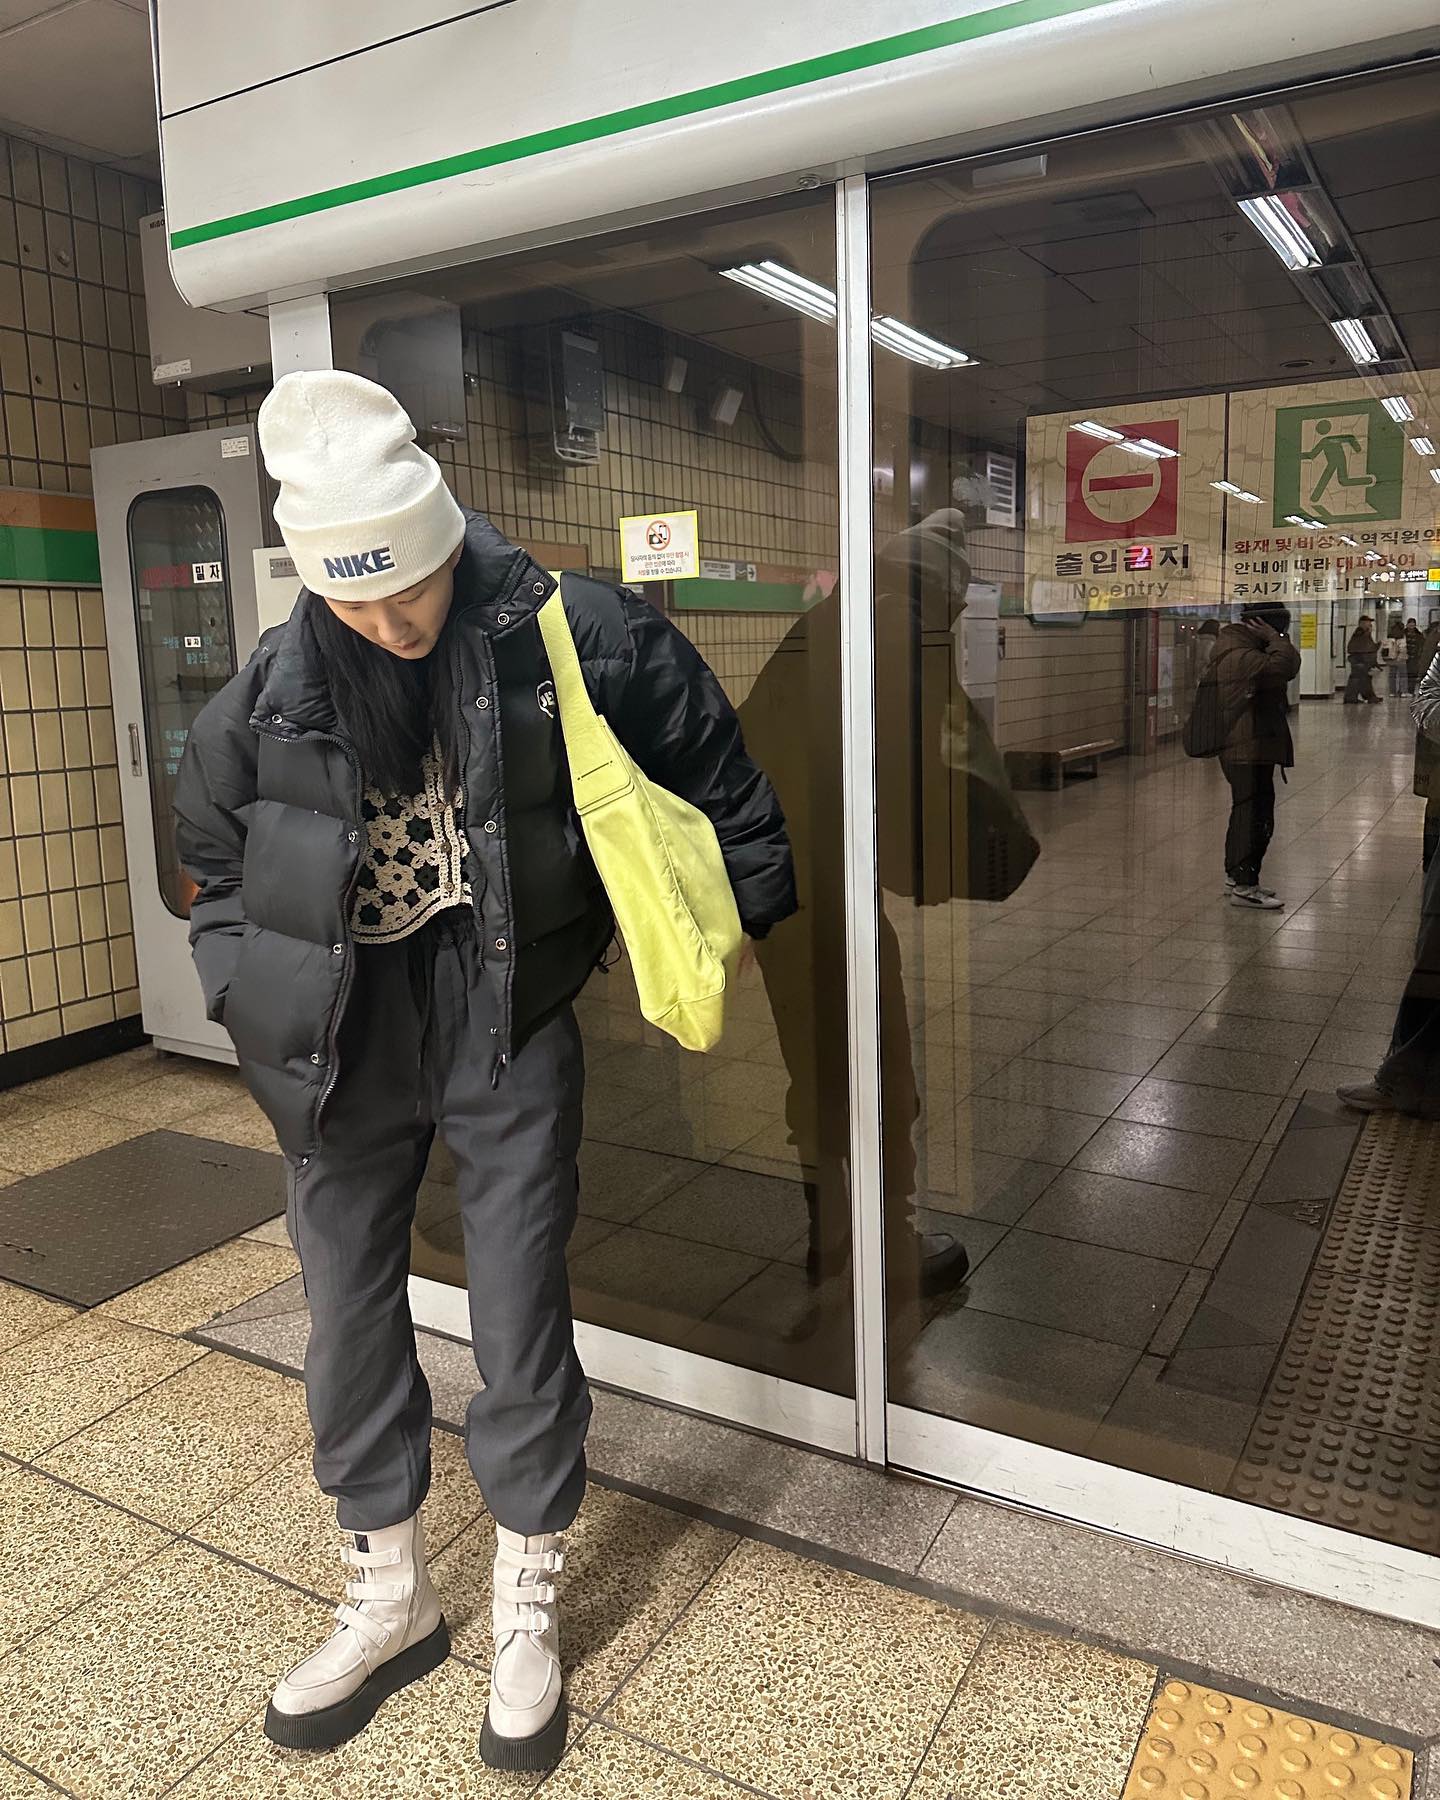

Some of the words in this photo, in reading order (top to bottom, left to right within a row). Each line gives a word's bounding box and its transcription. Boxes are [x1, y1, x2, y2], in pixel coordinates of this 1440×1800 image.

[1234, 538, 1270, 554] 화재
[1275, 538, 1293, 552] 및
[323, 546, 396, 579] NIKE
[1054, 543, 1190, 577] 출입금지
[1234, 558, 1288, 576] 안내에
[1294, 557, 1331, 573] 따라
[1072, 583, 1100, 599] No
[1110, 580, 1170, 598] entry
[1233, 581, 1288, 597] 주시기
